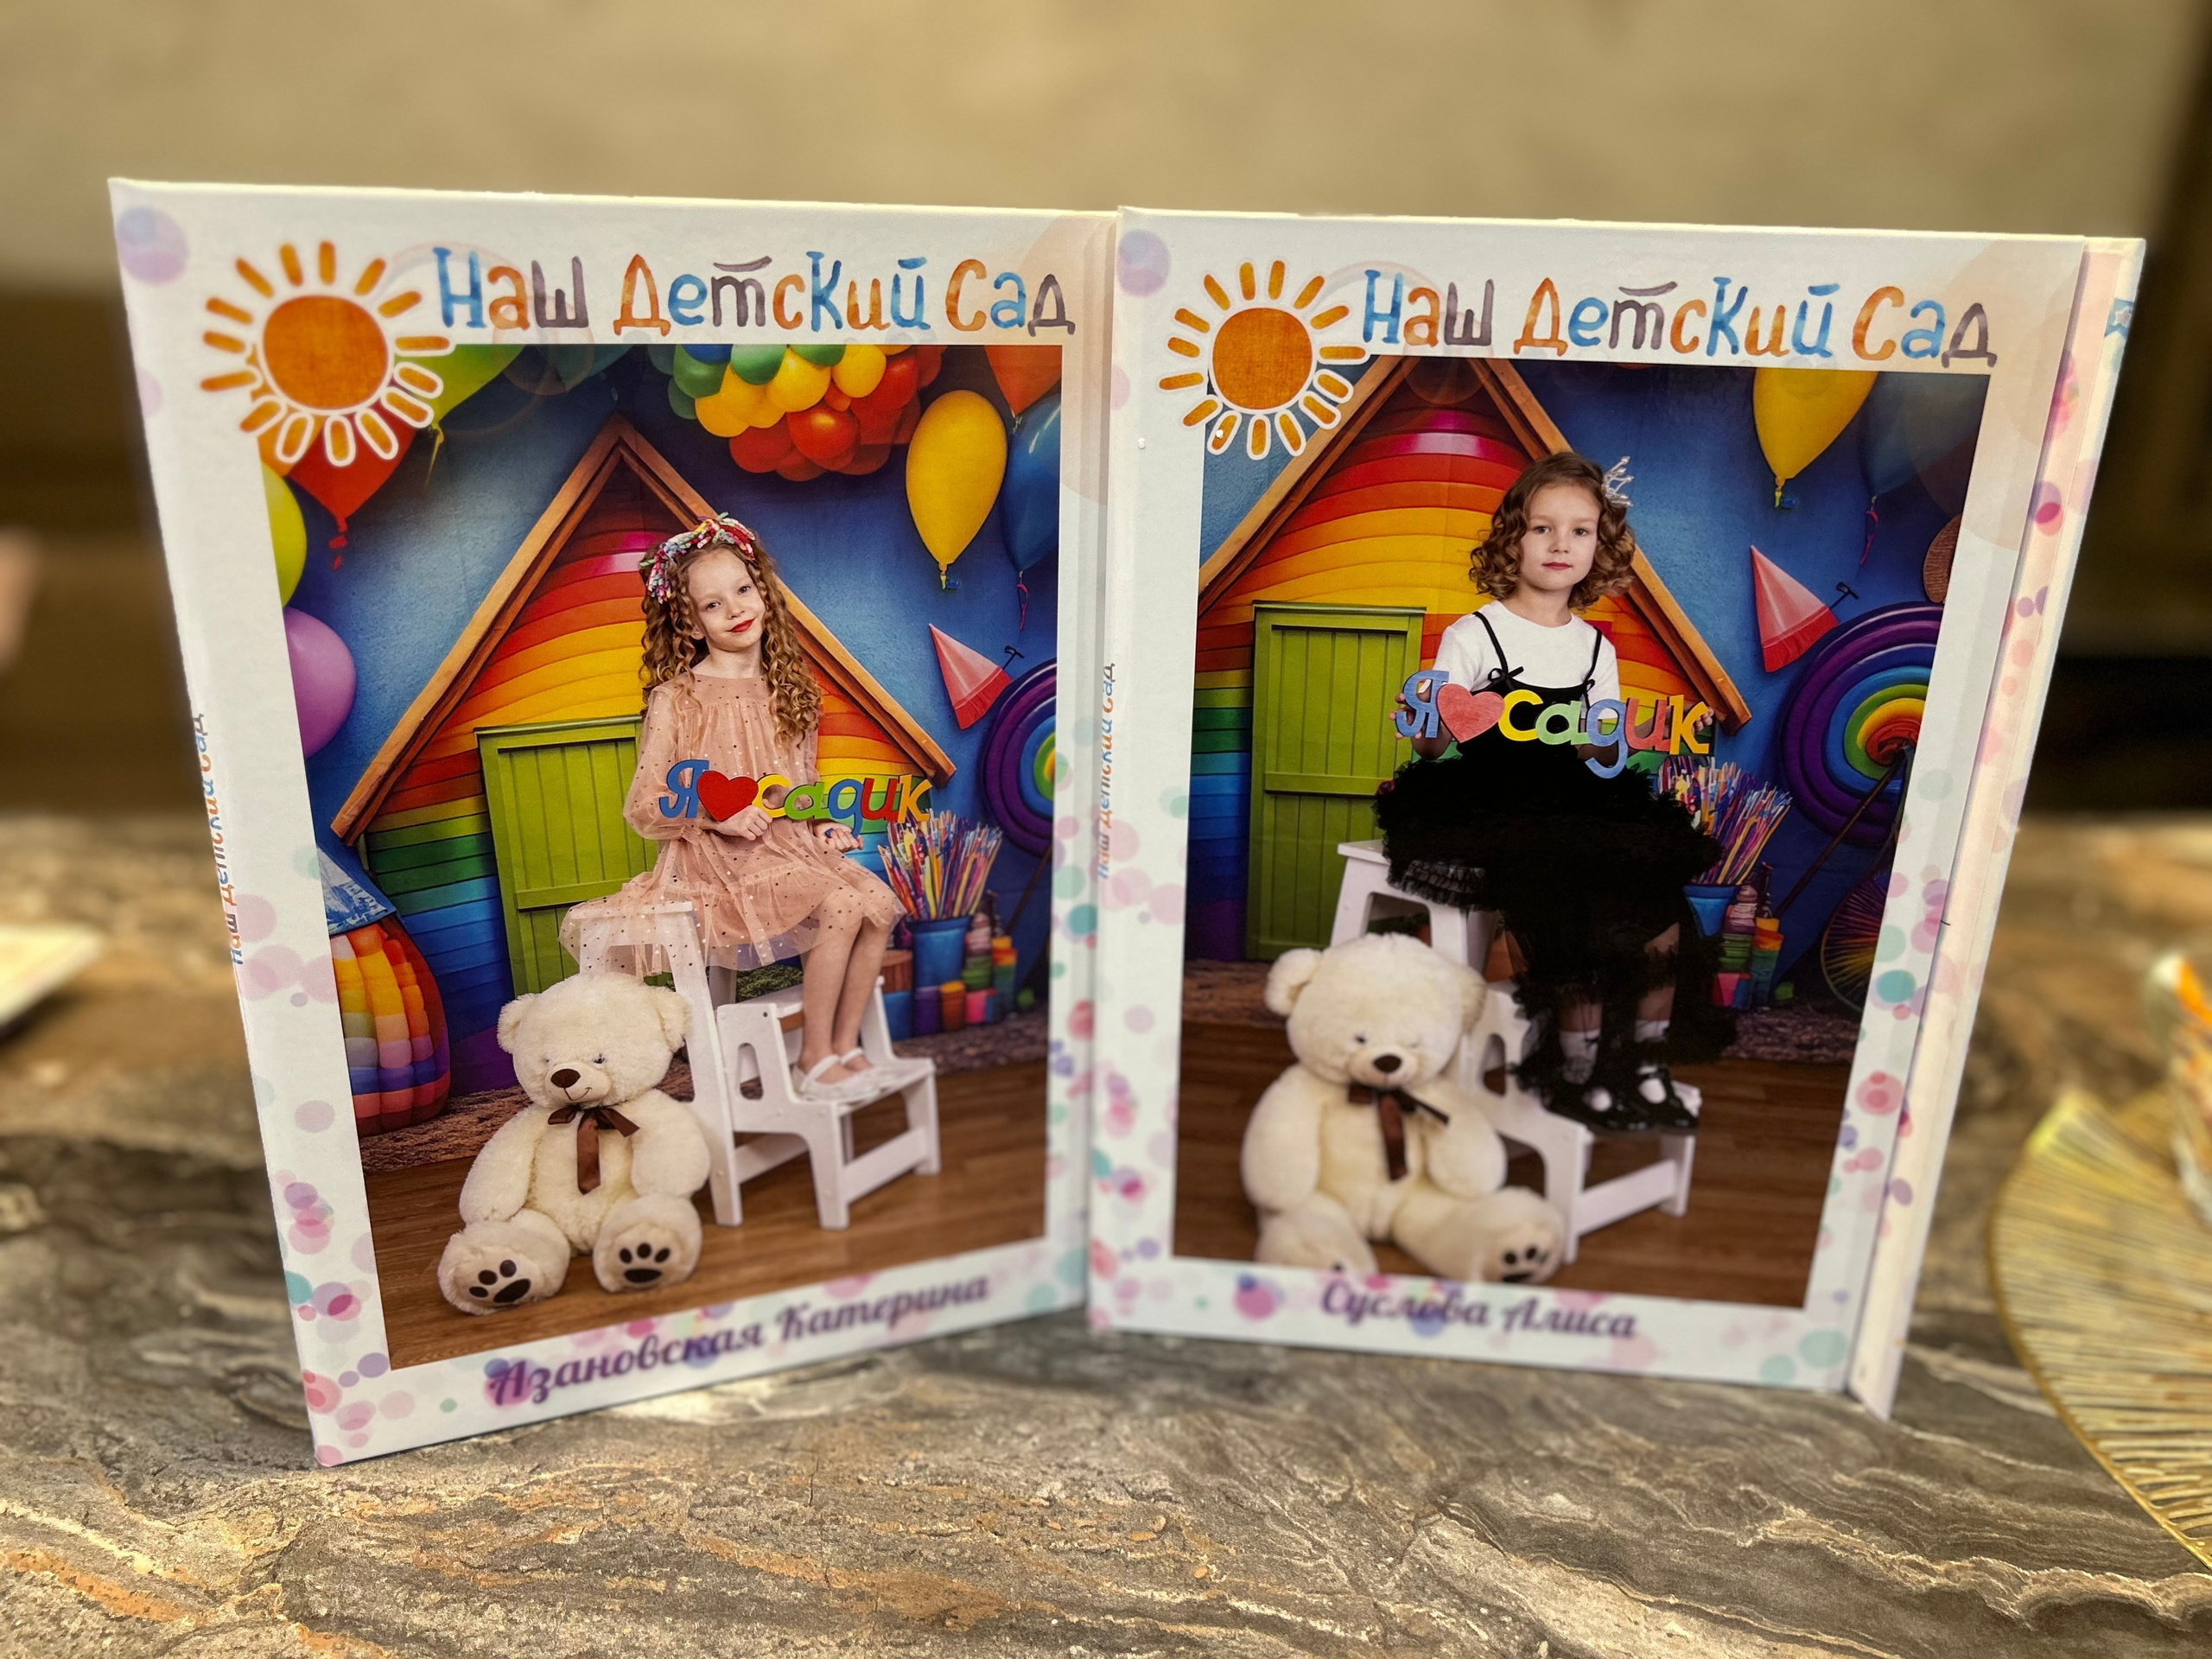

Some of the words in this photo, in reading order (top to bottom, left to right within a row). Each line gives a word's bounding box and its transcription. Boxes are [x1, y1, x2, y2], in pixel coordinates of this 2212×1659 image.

[432, 247, 589, 331] Наш
[613, 251, 931, 336] Детский
[945, 259, 1076, 335] Сад
[1362, 269, 1495, 347] Наш
[1513, 276, 1840, 359] Детский
[1852, 286, 1997, 368] Сад
[1395, 670, 1449, 738] Я
[658, 759, 709, 818] Я
[488, 1322, 766, 1407] Азановская
[775, 1274, 990, 1343] Катерина
[1321, 1277, 1490, 1327] Суслова
[1501, 1297, 1637, 1338] Алиса
